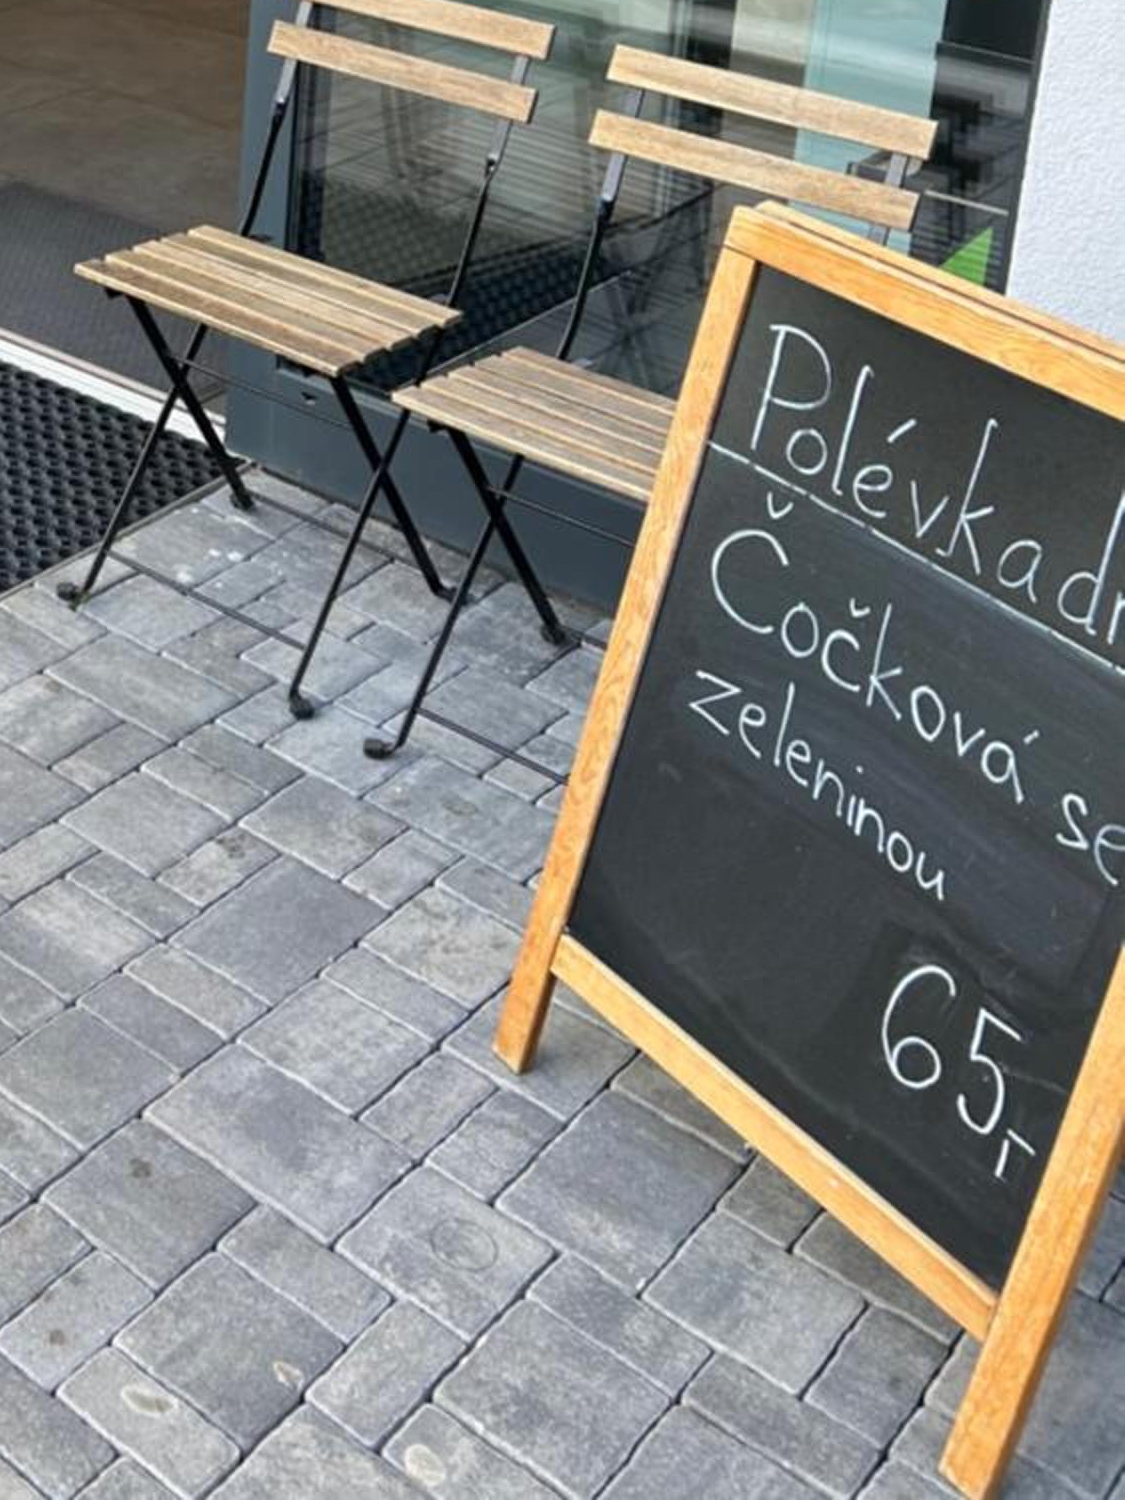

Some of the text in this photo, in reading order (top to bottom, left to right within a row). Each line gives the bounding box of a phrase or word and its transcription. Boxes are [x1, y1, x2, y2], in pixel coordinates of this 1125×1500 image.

[751, 324, 1038, 604] Polévka
[688, 670, 944, 901] zeleninou
[711, 491, 1125, 886] Čočková se
